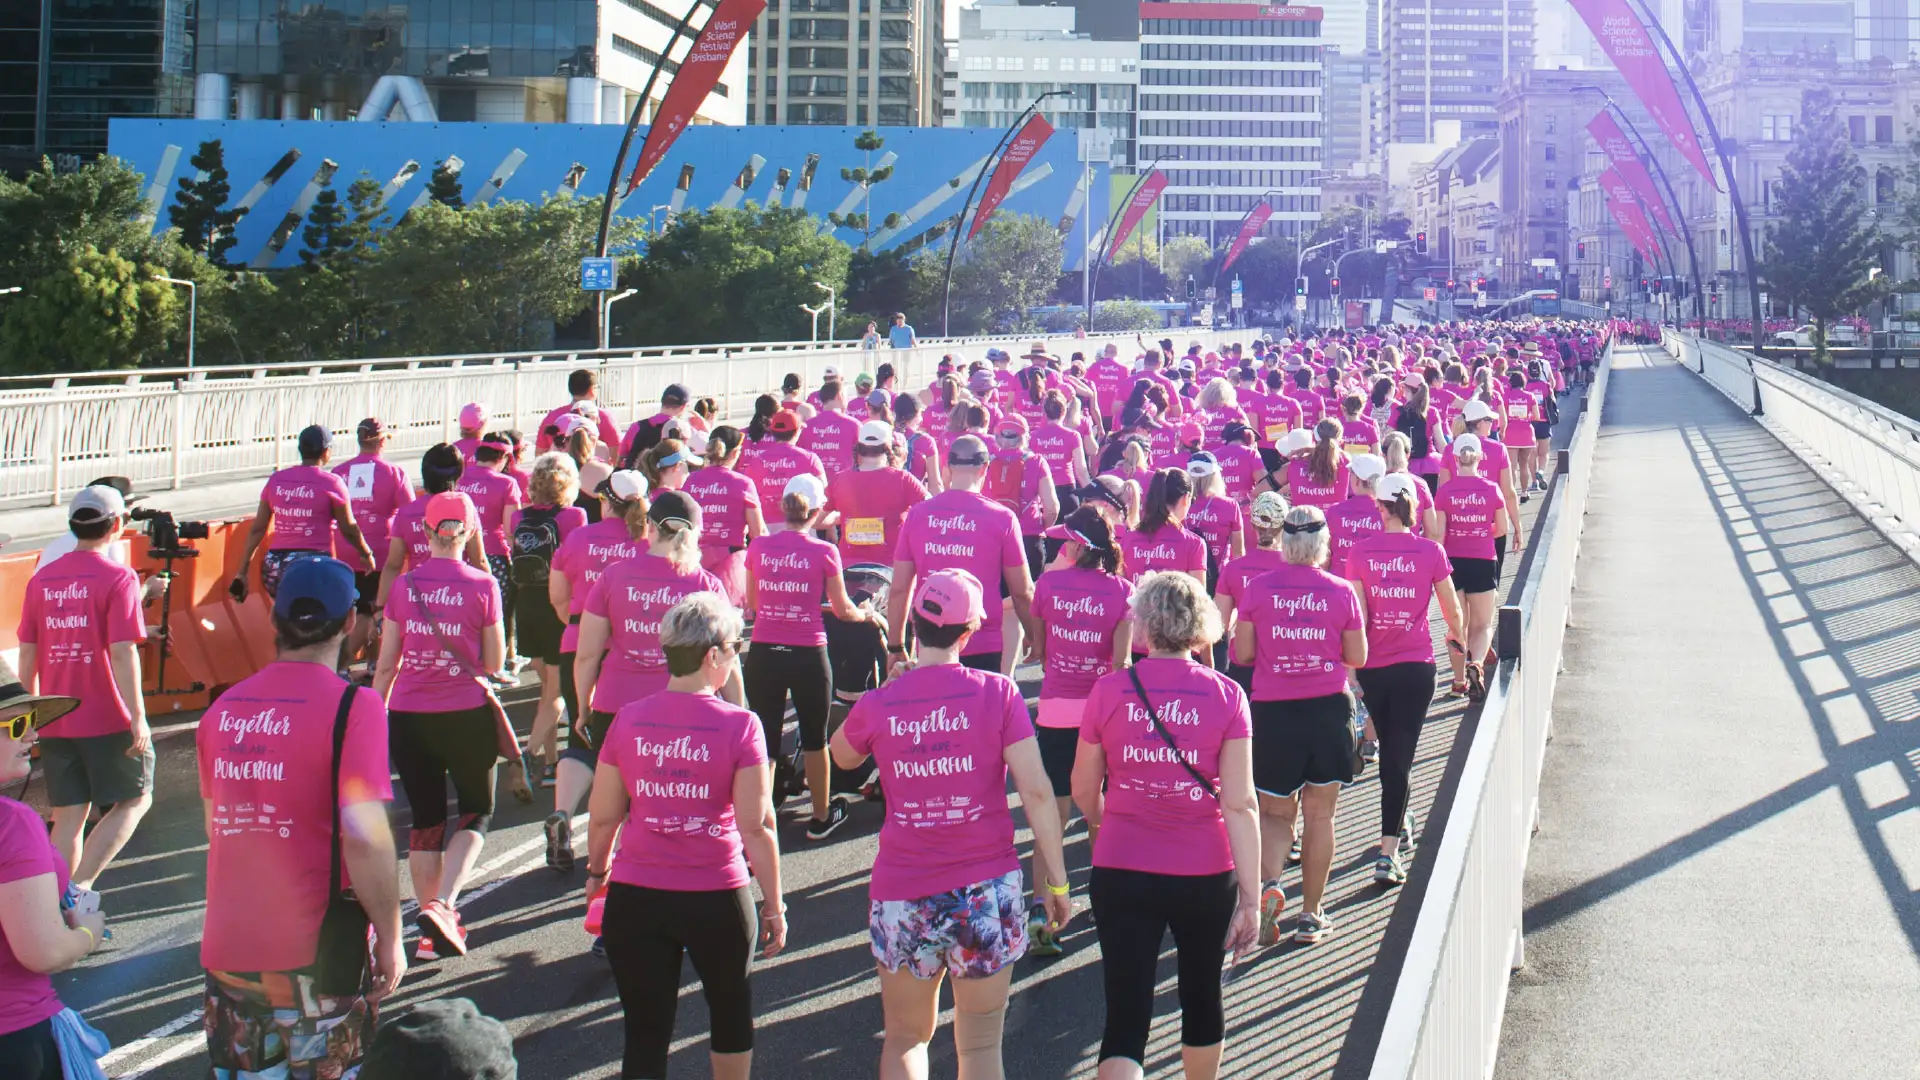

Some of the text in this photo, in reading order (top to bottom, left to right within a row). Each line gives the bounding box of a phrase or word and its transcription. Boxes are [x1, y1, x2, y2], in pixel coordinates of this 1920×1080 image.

[714, 21, 737, 30] World
[1603, 16, 1630, 26] World
[706, 31, 735, 40] Science
[1602, 26, 1638, 36] Science
[700, 41, 731, 51] Festival
[1610, 36, 1644, 46] Festival
[691, 53, 728, 63] Brisbane
[1615, 46, 1653, 57] Brisbane
[762, 457, 796, 472] Together
[275, 483, 316, 501] Together
[690, 482, 729, 497] Together
[1449, 493, 1487, 510] Together
[928, 514, 977, 535] Together
[1341, 516, 1383, 533] Together
[588, 542, 636, 562] Together
[925, 542, 975, 557] POWERFUL
[1132, 544, 1176, 565] Together
[760, 553, 811, 573] Together
[1367, 556, 1416, 578] Together
[42, 581, 89, 607] Together
[758, 579, 810, 593] POWERFUL
[1052, 595, 1106, 619] Together
[1271, 592, 1329, 617] Together
[1052, 624, 1102, 644] POWERFUL
[1272, 624, 1327, 641] POWERFUL
[218, 707, 291, 744] Together
[888, 705, 971, 745] Together
[634, 735, 711, 768] Together
[214, 757, 286, 782] POWERFUL
[893, 754, 976, 779] POWERFUL
[636, 778, 712, 800] POWERFUL
